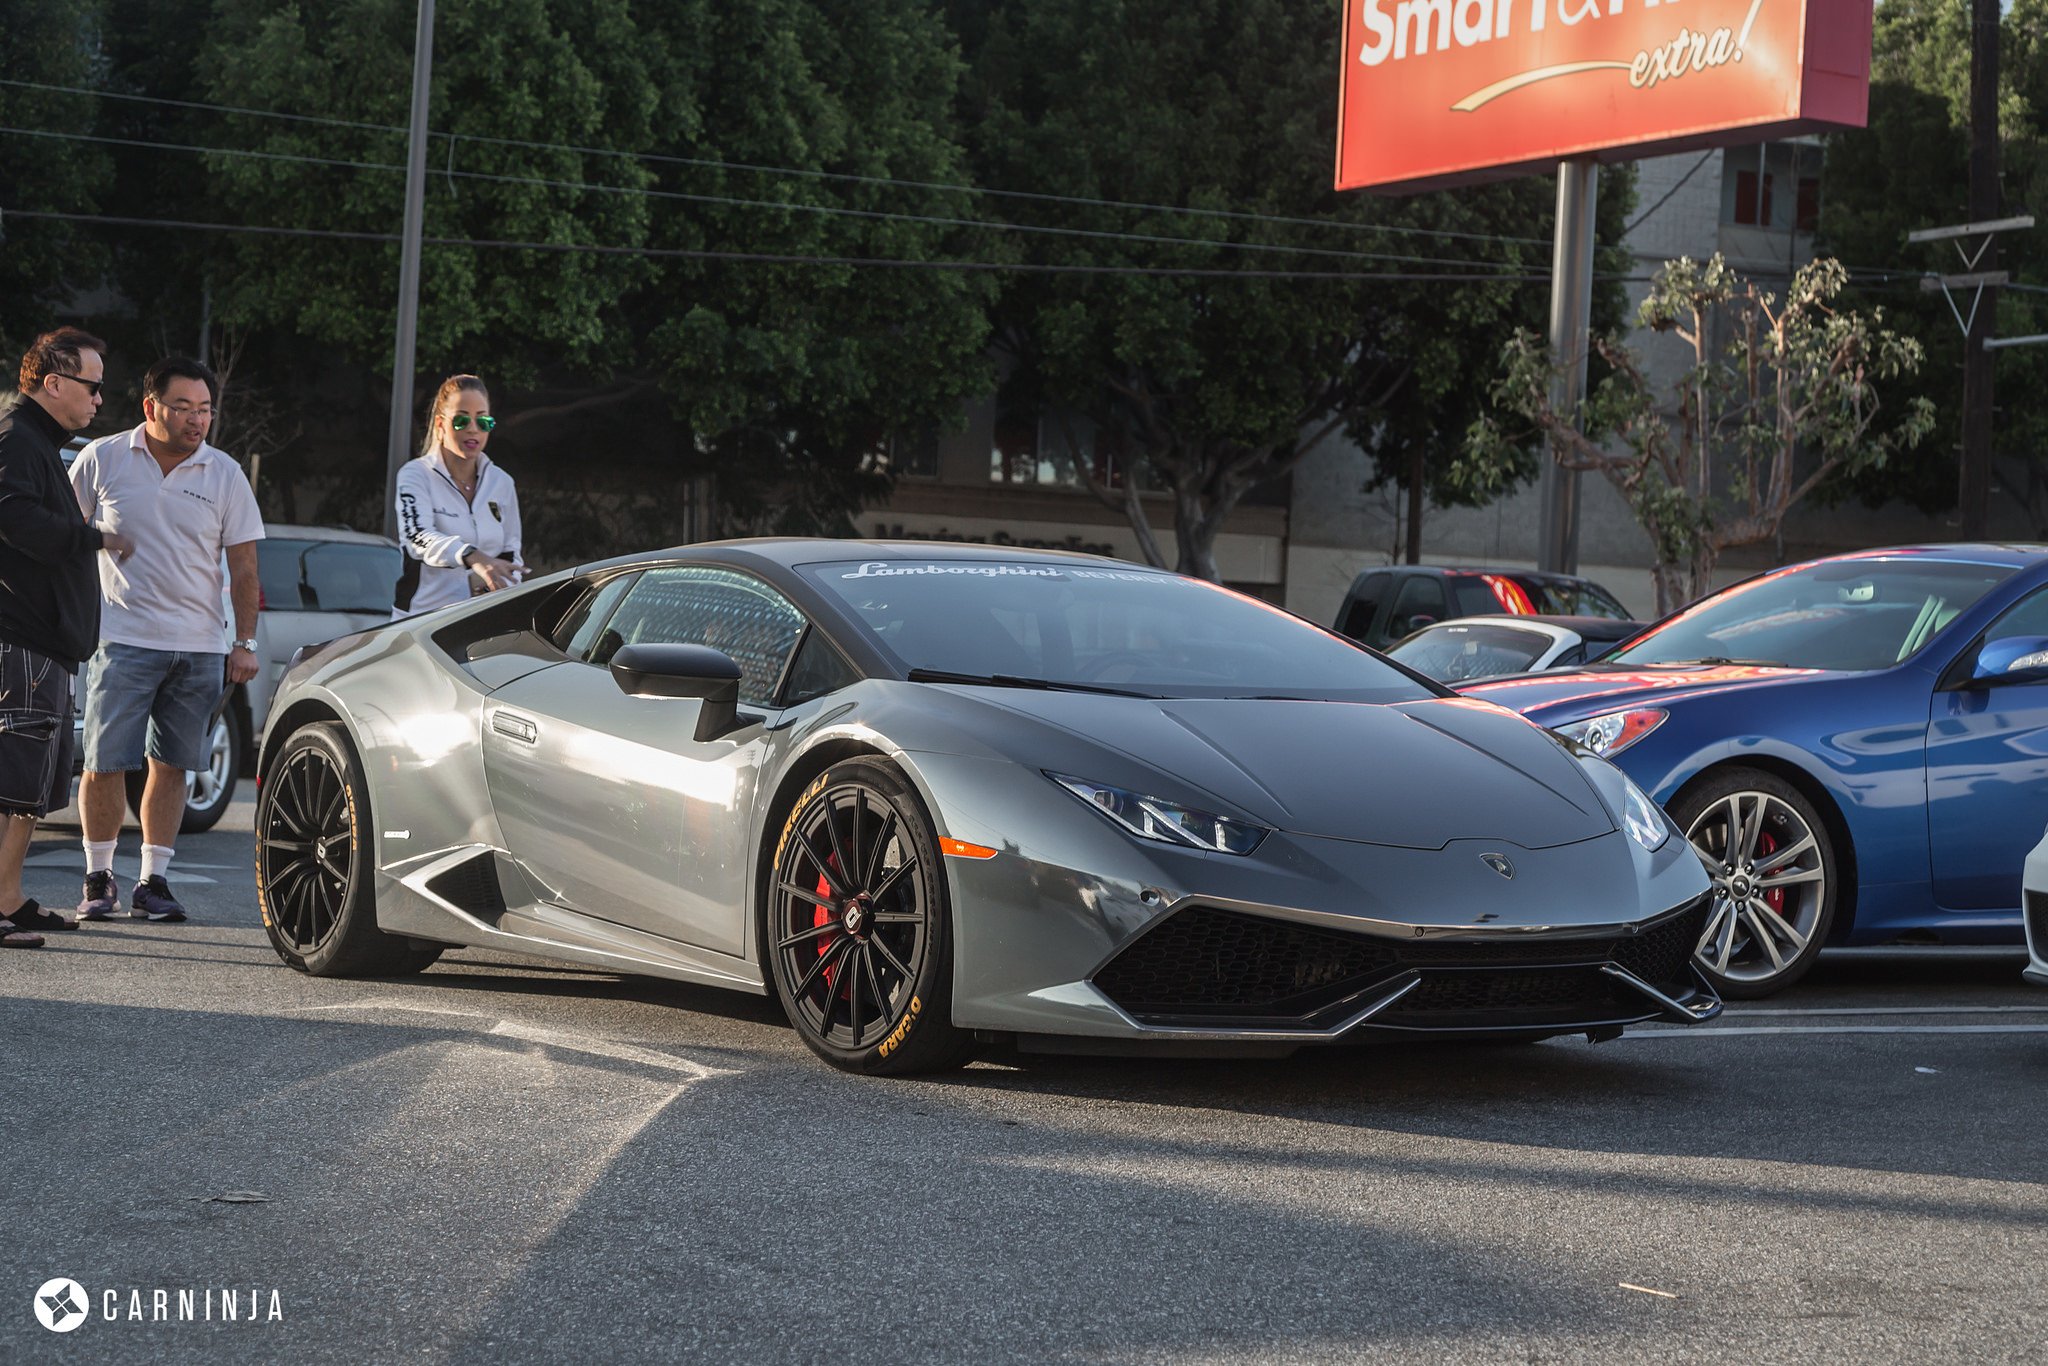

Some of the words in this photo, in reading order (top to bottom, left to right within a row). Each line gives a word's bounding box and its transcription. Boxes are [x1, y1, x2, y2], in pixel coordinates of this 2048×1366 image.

[1629, 0, 1763, 88] extra!
[842, 562, 1064, 579] Lamborghini
[774, 773, 829, 870] PIRELLI
[879, 995, 922, 1058] O'GARA
